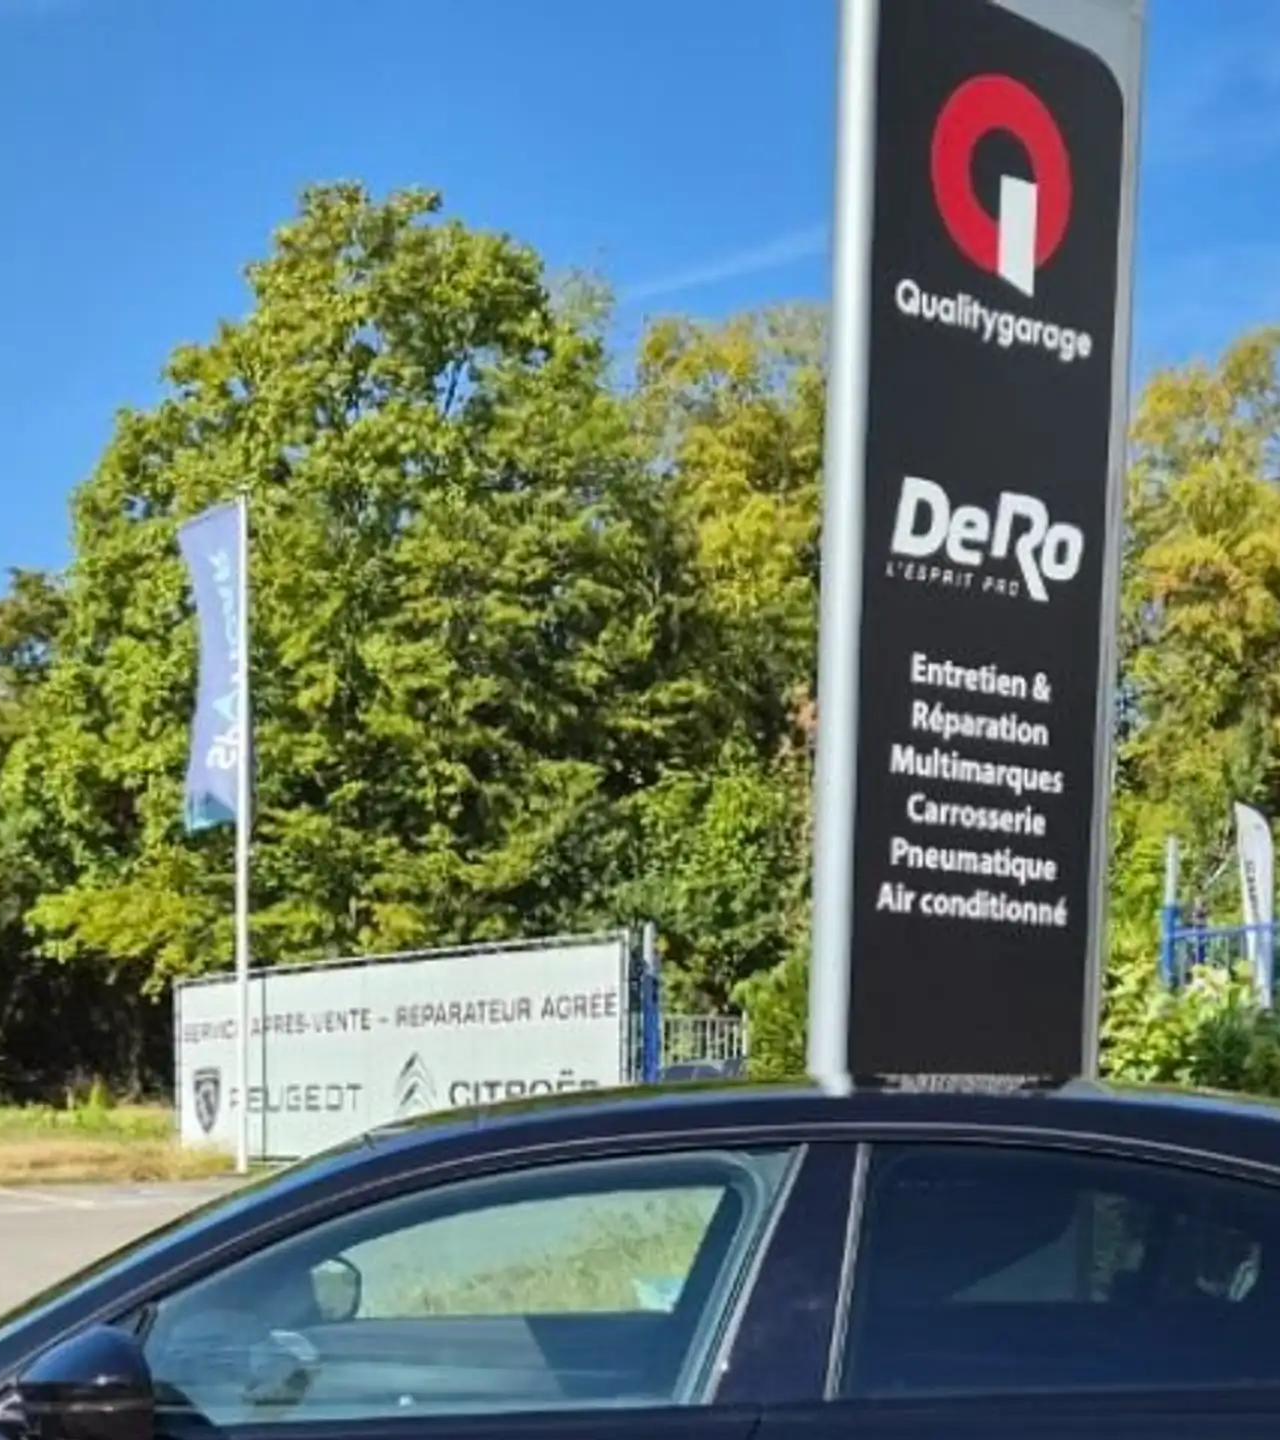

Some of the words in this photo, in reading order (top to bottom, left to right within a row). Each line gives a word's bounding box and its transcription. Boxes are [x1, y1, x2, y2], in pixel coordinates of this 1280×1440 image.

[895, 278, 1092, 362] Qualitygarage
[891, 476, 1084, 602] DeRo
[910, 652, 1026, 698] Entretien
[1032, 672, 1051, 702] &
[911, 701, 1049, 745] Réparation
[889, 744, 1064, 795] Multimarques
[906, 793, 1047, 835] Carrosserie
[890, 837, 1058, 884] Pneumatique
[876, 883, 917, 913] Air
[920, 888, 1068, 927] conditionné
[183, 1019, 240, 1044] SERVIC
[449, 1067, 599, 1107] CITROË
